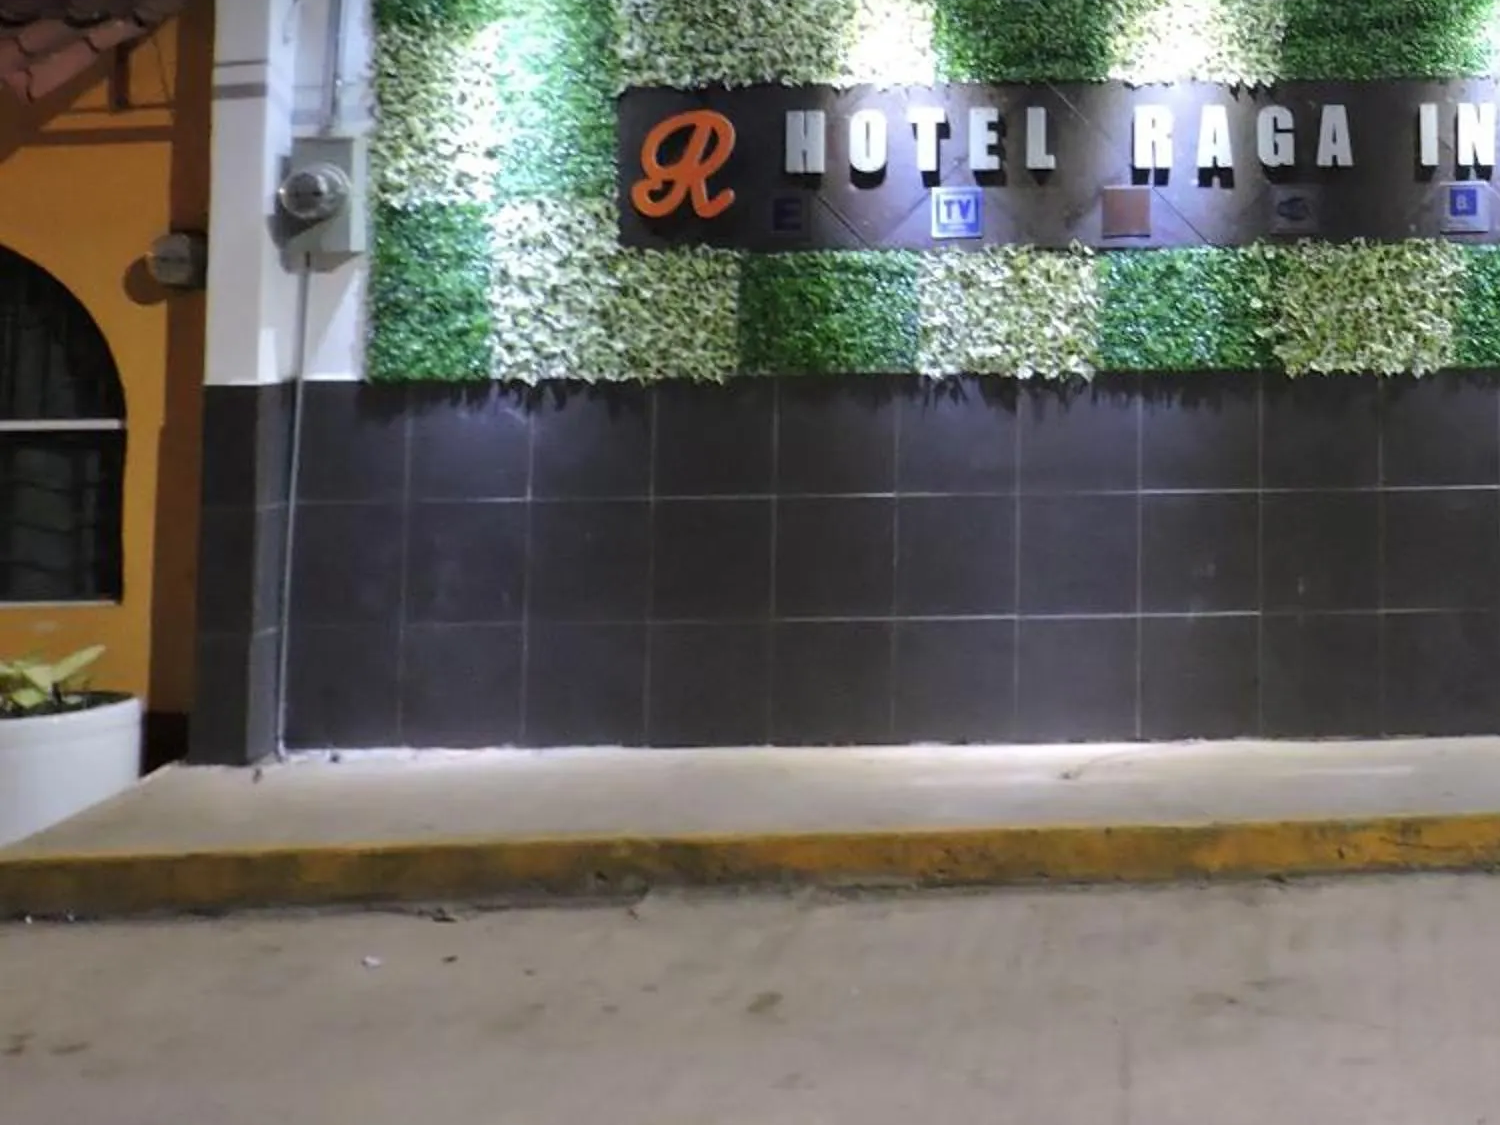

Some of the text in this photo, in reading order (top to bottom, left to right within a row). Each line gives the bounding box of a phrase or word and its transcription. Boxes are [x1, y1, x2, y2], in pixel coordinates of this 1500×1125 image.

[784, 104, 1056, 174] HOTEL
[1132, 103, 1354, 171] RAGA
[943, 198, 972, 220] TV
